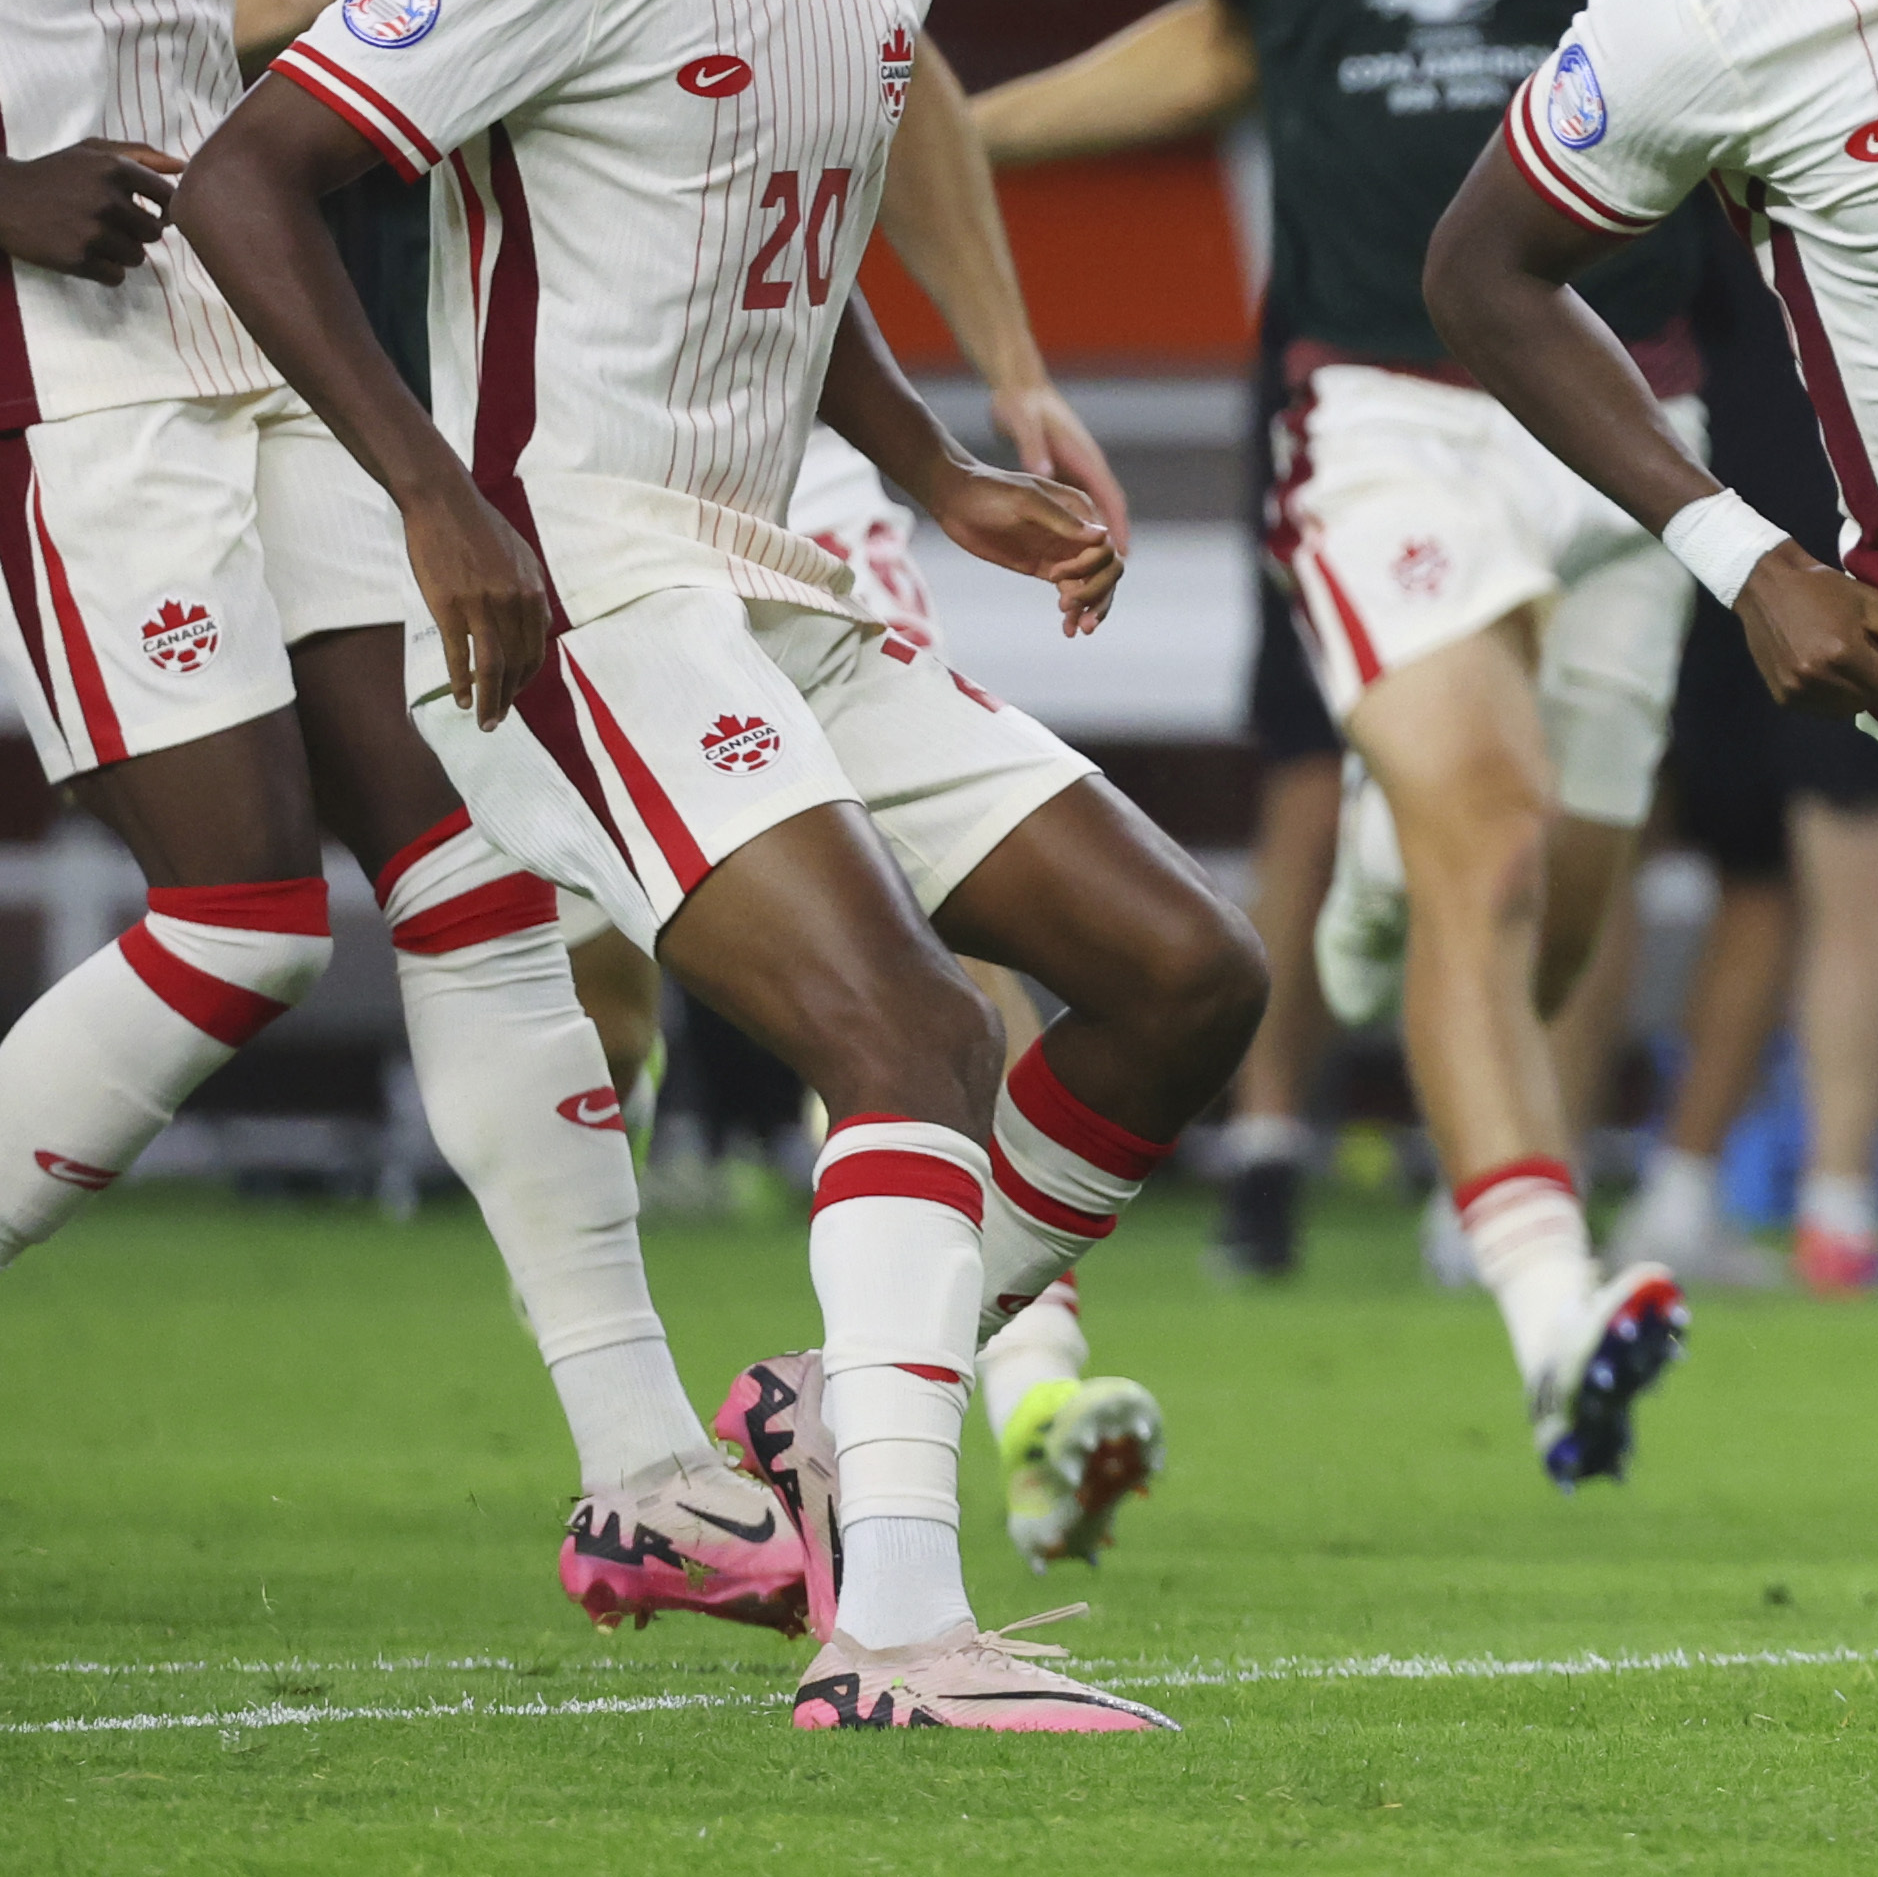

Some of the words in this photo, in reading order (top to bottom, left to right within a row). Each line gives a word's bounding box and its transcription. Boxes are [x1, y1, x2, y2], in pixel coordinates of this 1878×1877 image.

[743, 169, 852, 311] 20
[143, 620, 217, 652] CANADA
[704, 726, 777, 761] CANADA
